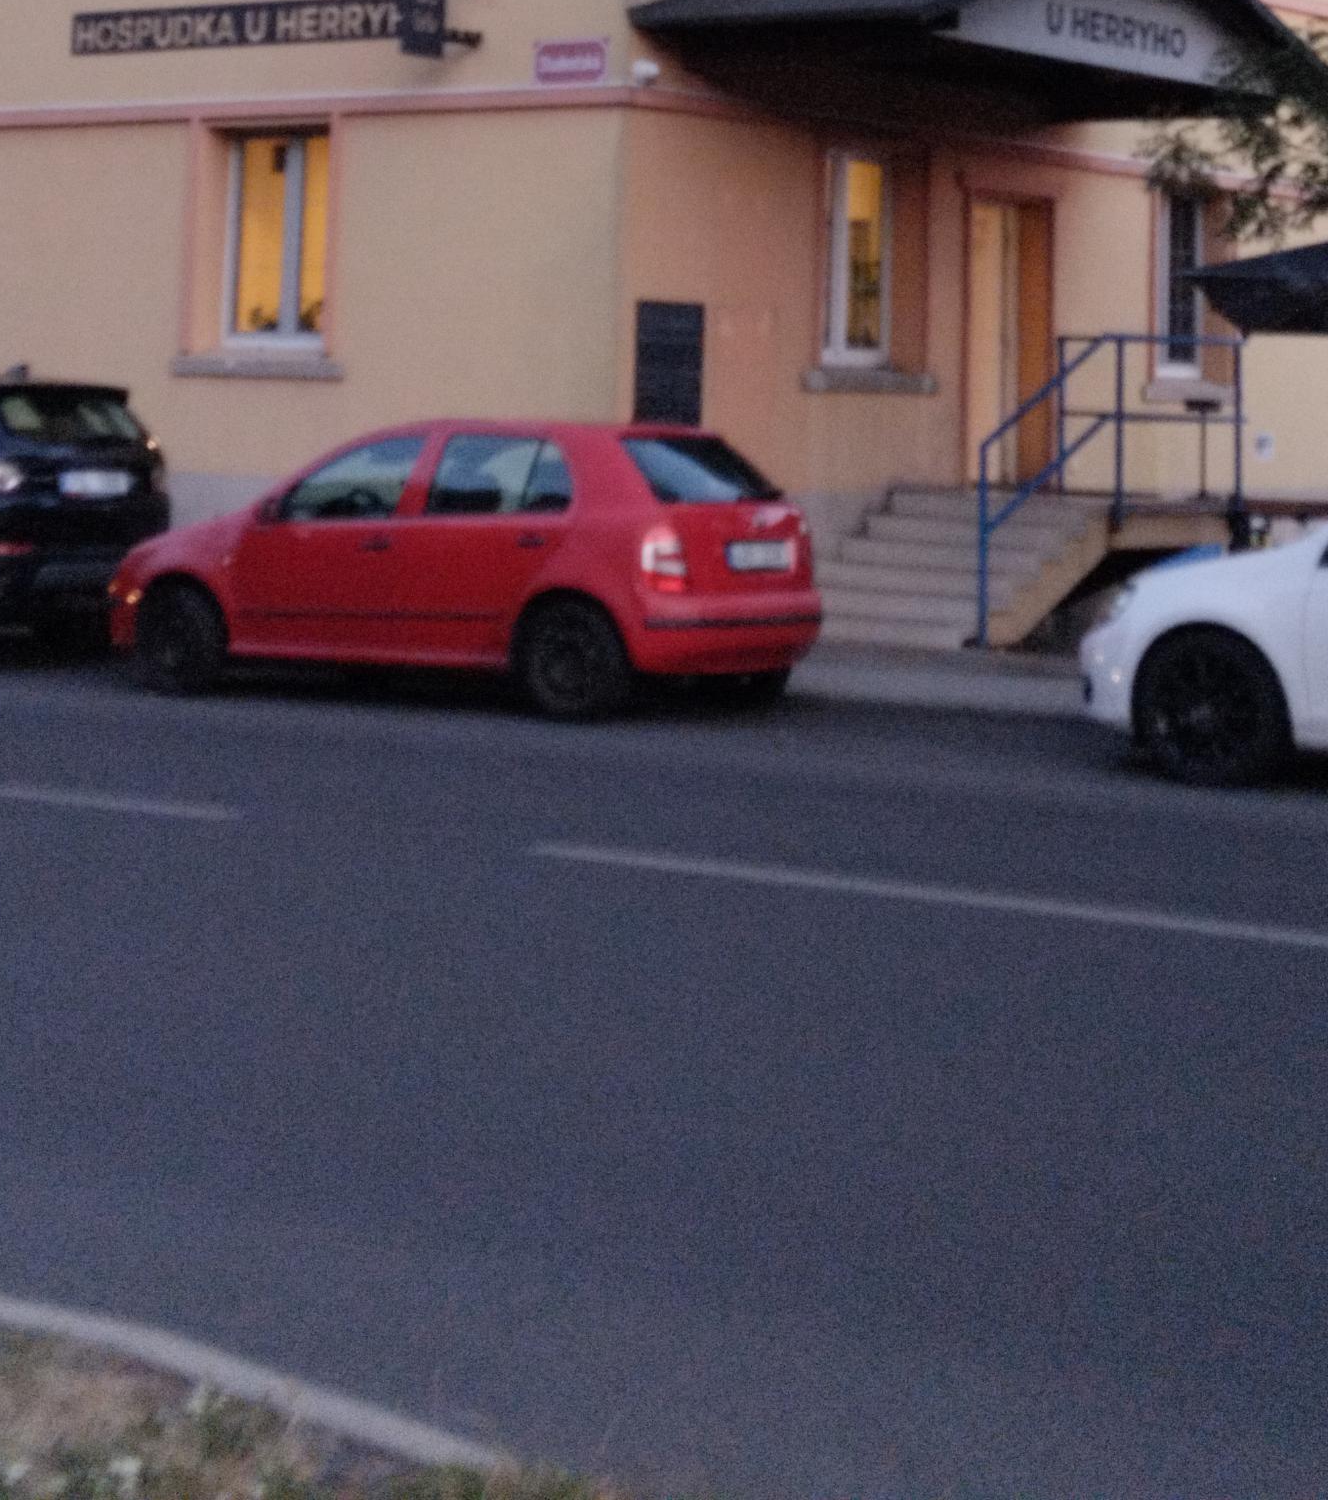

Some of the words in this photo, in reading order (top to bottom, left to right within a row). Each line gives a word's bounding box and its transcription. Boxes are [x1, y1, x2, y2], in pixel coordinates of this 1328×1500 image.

[75, 10, 235, 49] HOSPUDKA
[245, 8, 267, 43] U
[1045, 1, 1065, 35] U
[1068, 6, 1187, 58] HERRYHO
